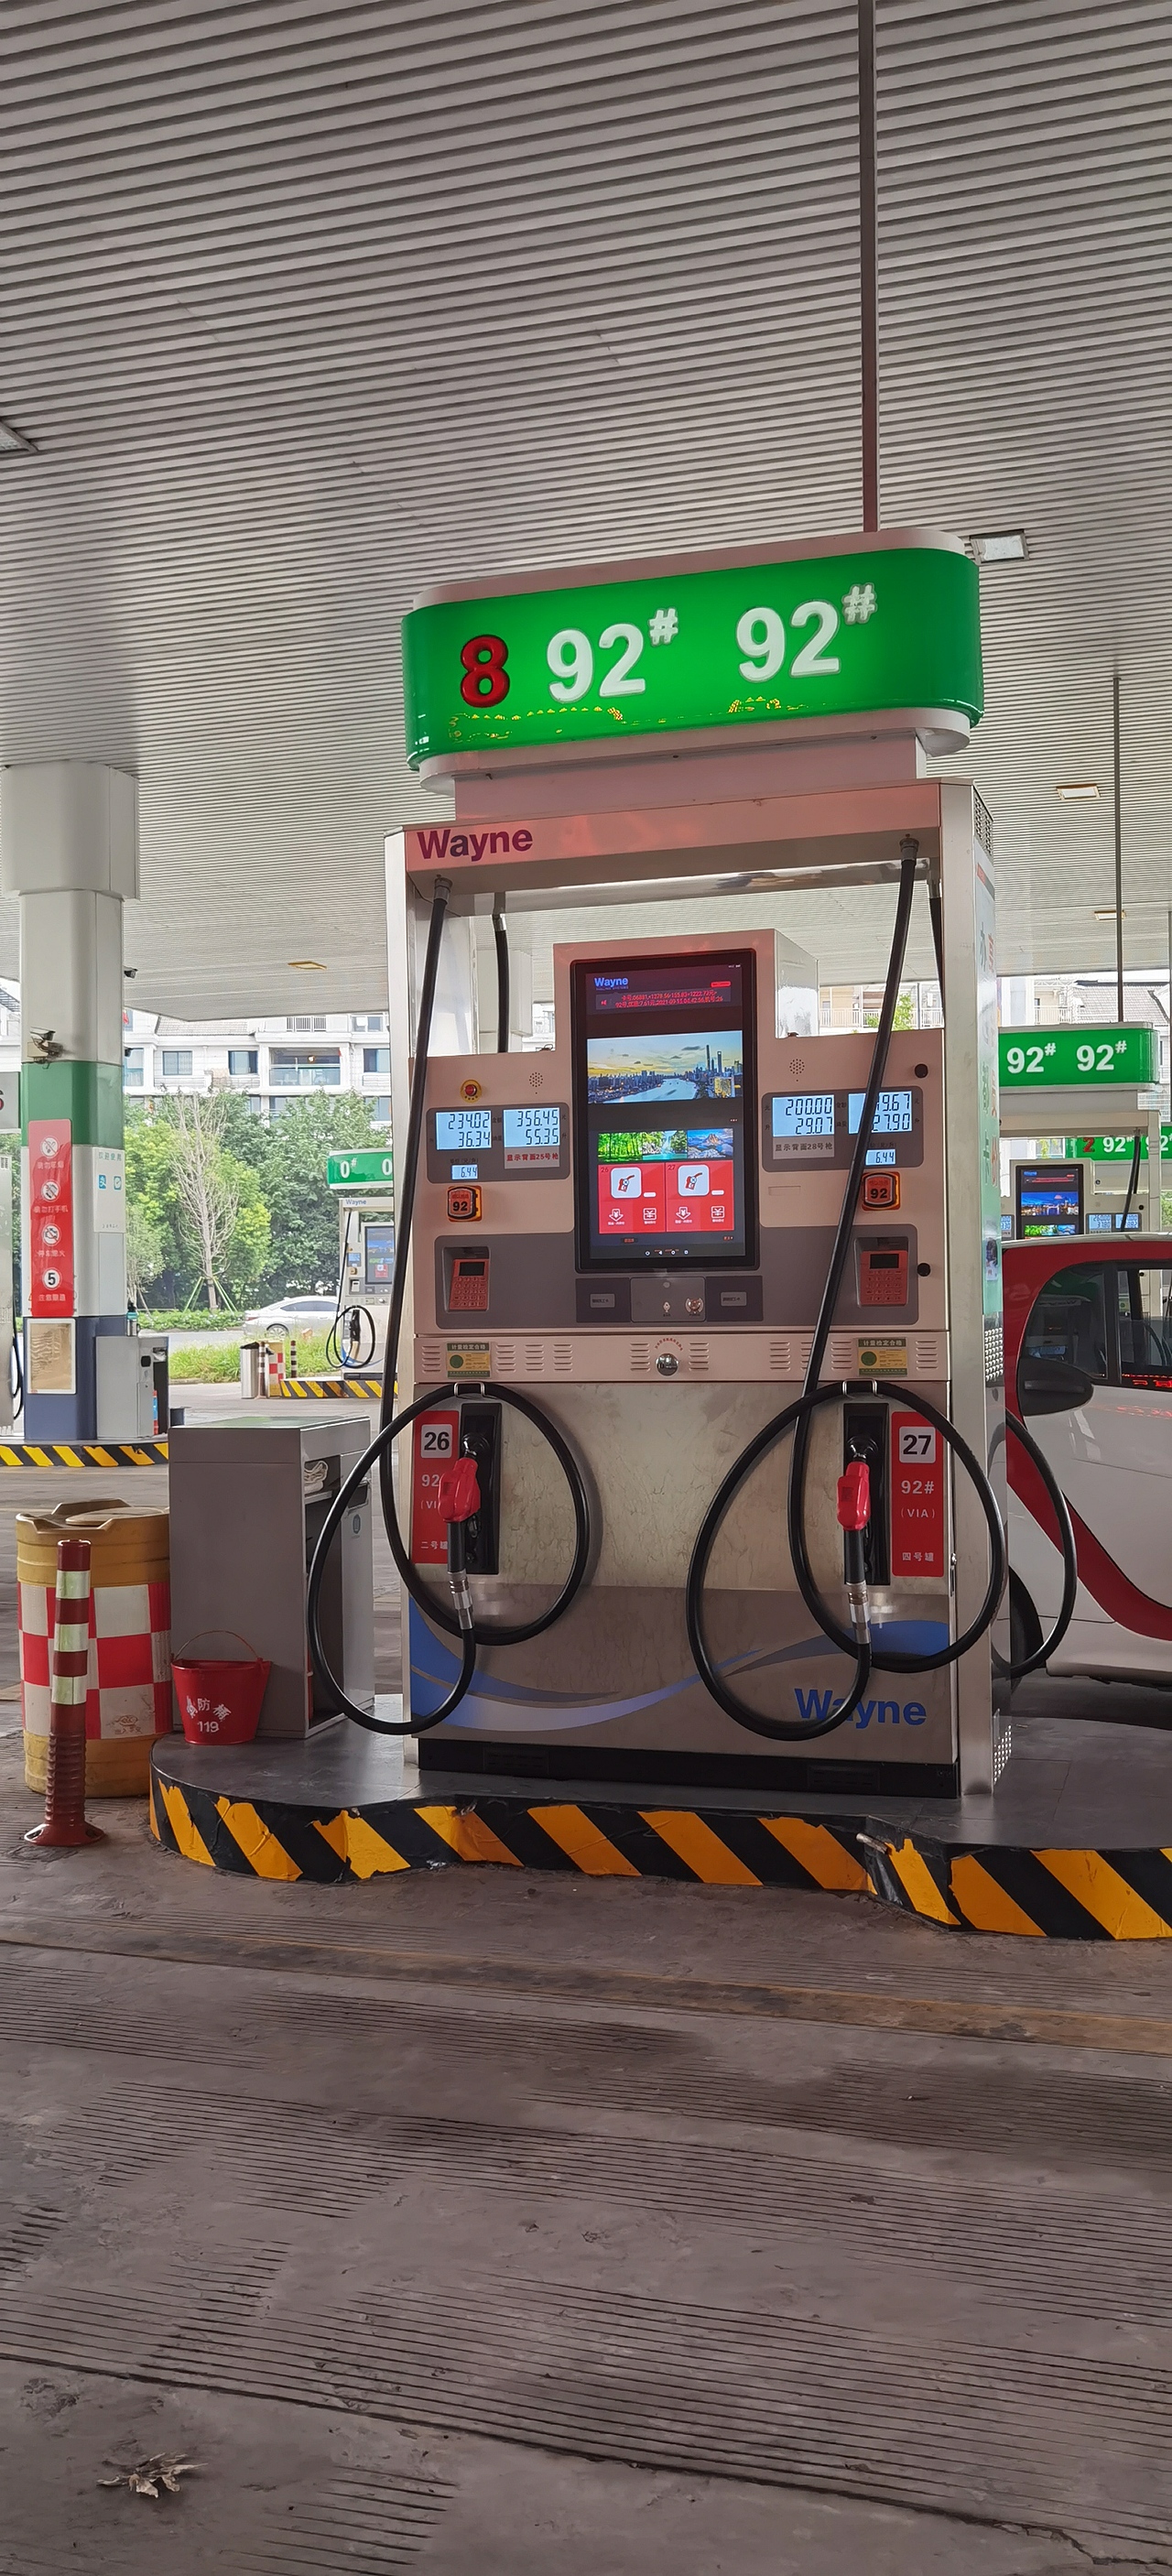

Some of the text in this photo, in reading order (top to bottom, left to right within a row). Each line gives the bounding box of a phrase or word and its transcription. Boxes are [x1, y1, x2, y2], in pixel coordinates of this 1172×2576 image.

[461, 583, 877, 708] 8 92# 92#
[418, 826, 533, 862] Wayne
[594, 977, 629, 988] Wayne
[1007, 1040, 1127, 1074] 92# 92#
[786, 1097, 832, 1115] 200.00
[516, 1109, 559, 1127] 356.45
[796, 1117, 832, 1135] 29.07
[458, 1131, 491, 1147] 36.34
[525, 1127, 559, 1145] 55.35
[775, 1142, 833, 1152] 显示背面28号枪
[1082, 1137, 1095, 1153] 2
[506, 1152, 559, 1162] 显示背面25号枪
[876, 1151, 895, 1164] 6.44
[461, 1167, 477, 1178] 6.44
[871, 1188, 888, 1199] 92
[452, 1201, 468, 1212] 92
[48, 1273, 56, 1286] 5
[424, 1431, 450, 1451] 26
[903, 1434, 931, 1455] 27
[421, 1473, 440, 1487] 92
[901, 1480, 935, 1495] 92#
[198, 1721, 220, 1733] 119
